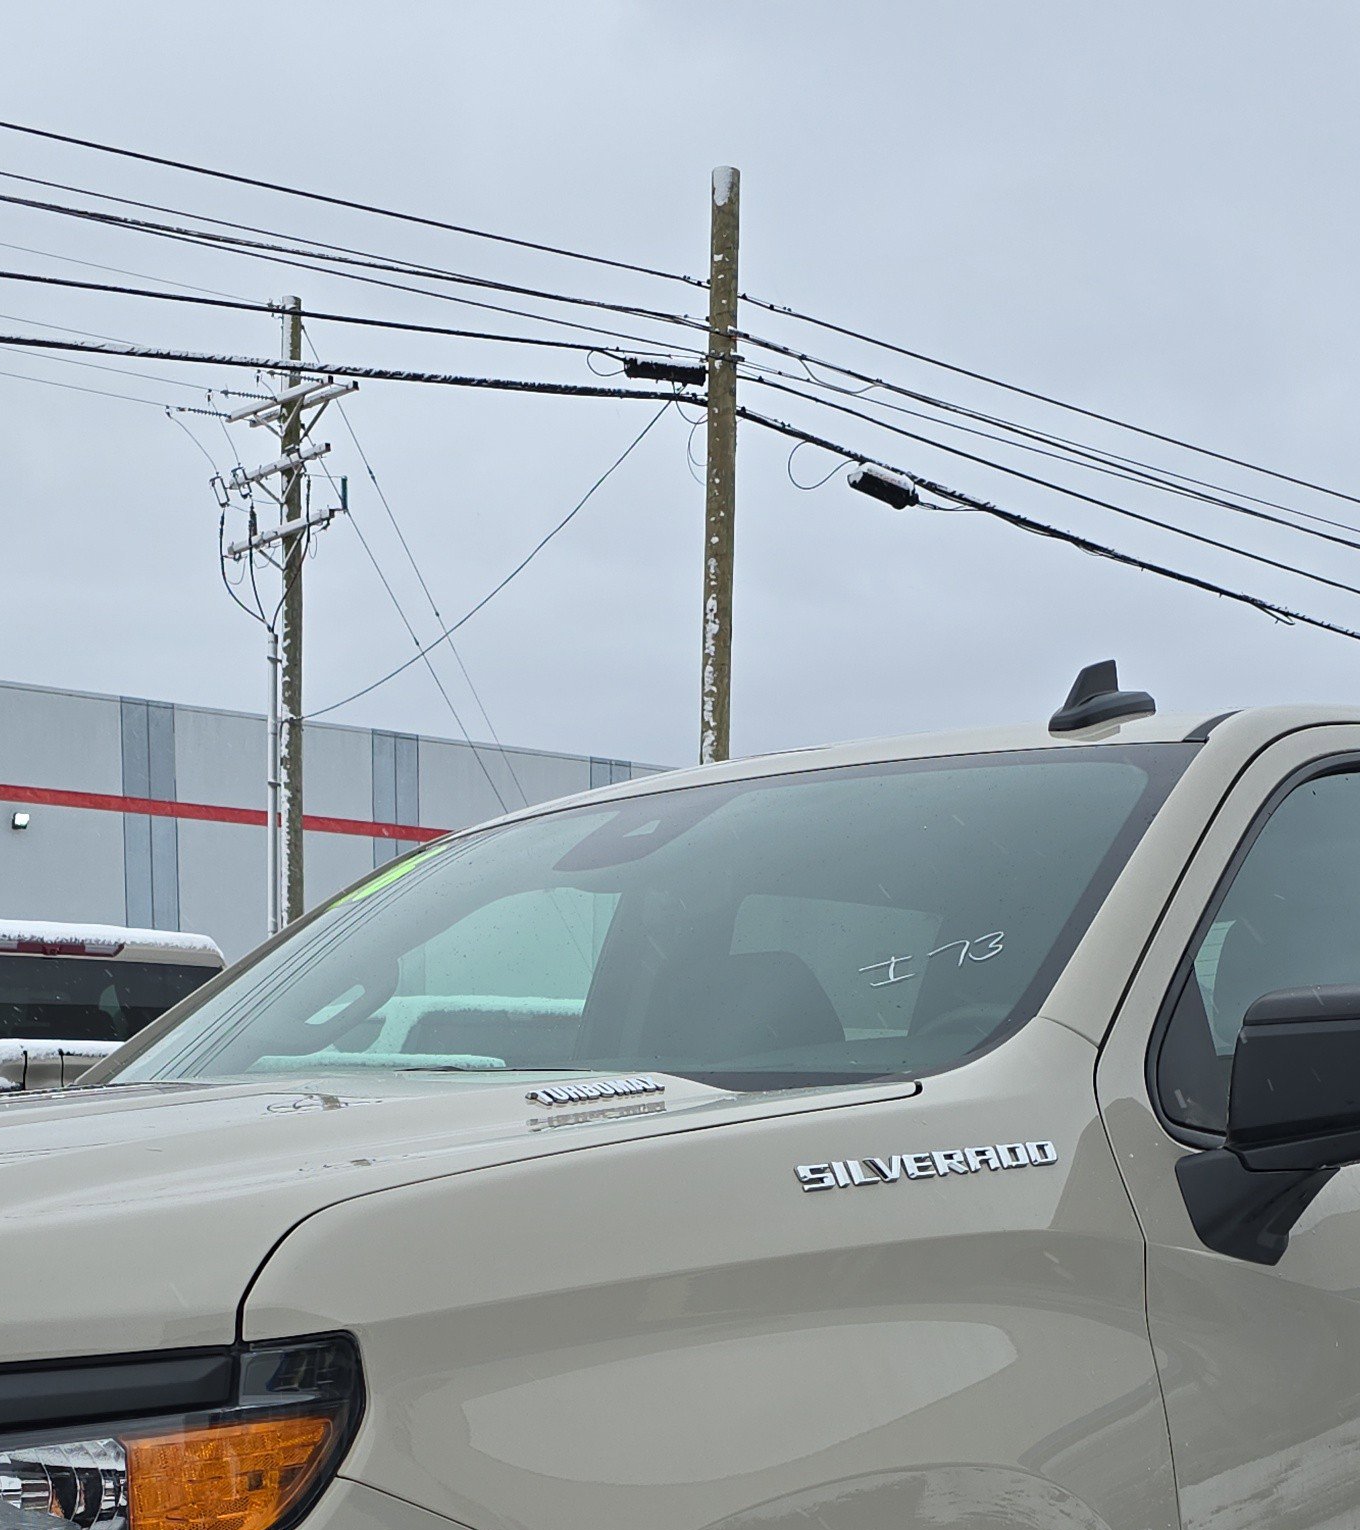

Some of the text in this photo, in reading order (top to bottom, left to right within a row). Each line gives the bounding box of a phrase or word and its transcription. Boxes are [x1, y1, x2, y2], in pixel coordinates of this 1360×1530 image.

[927, 931, 1005, 967] 73
[525, 1076, 666, 1107] TURBOMAX
[794, 1140, 1058, 1192] SILVERADO
